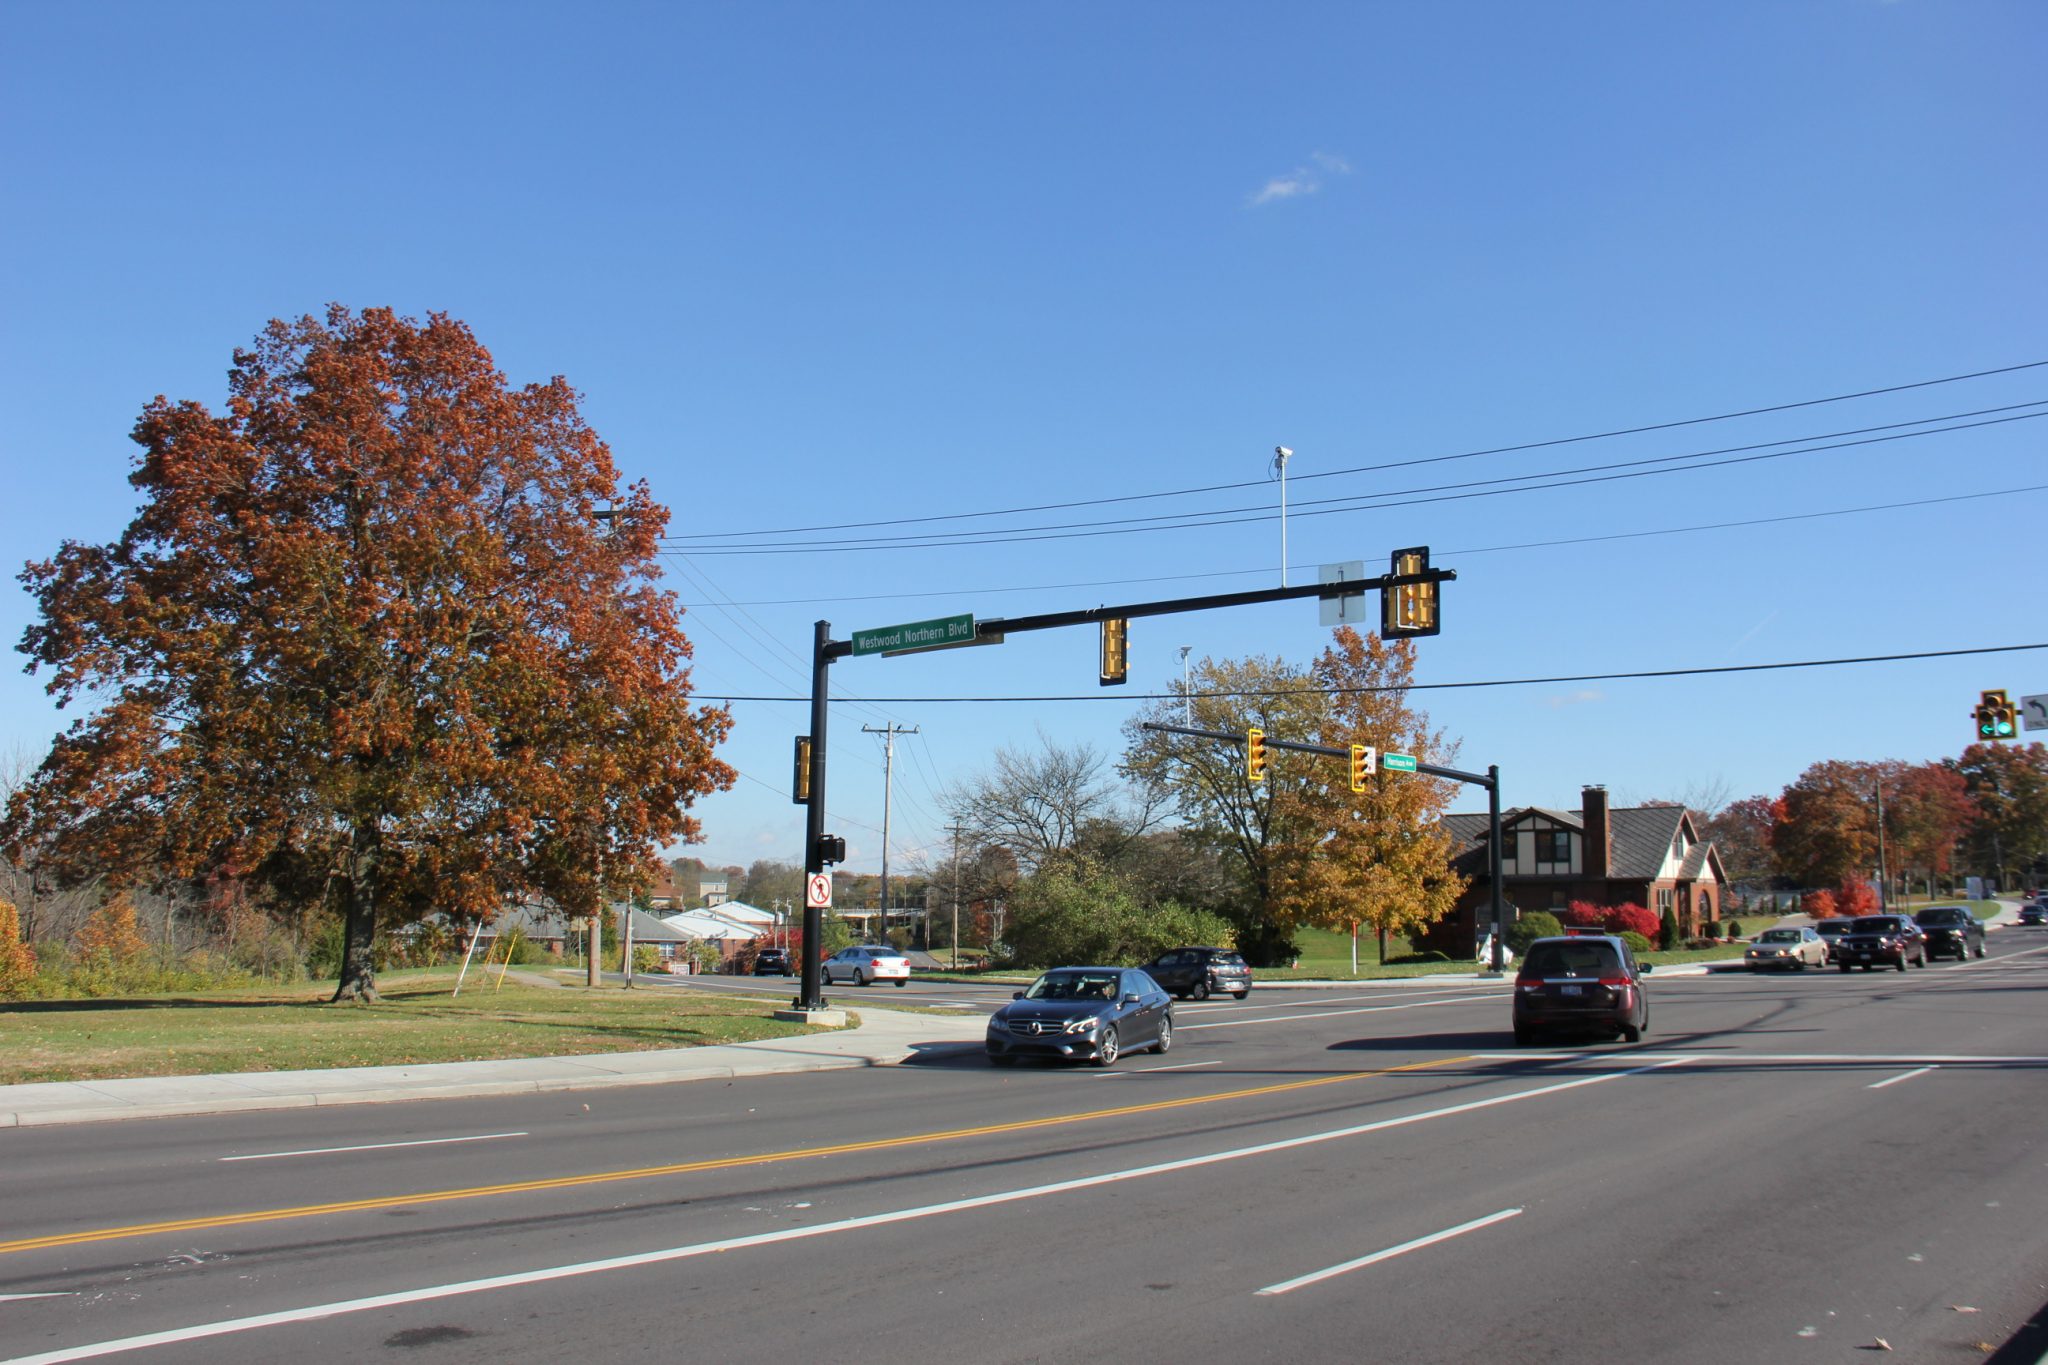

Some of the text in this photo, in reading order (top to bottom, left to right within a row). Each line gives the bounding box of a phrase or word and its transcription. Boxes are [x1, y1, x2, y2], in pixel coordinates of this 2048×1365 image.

[858, 621, 968, 649] Westwood Northern Blvd
